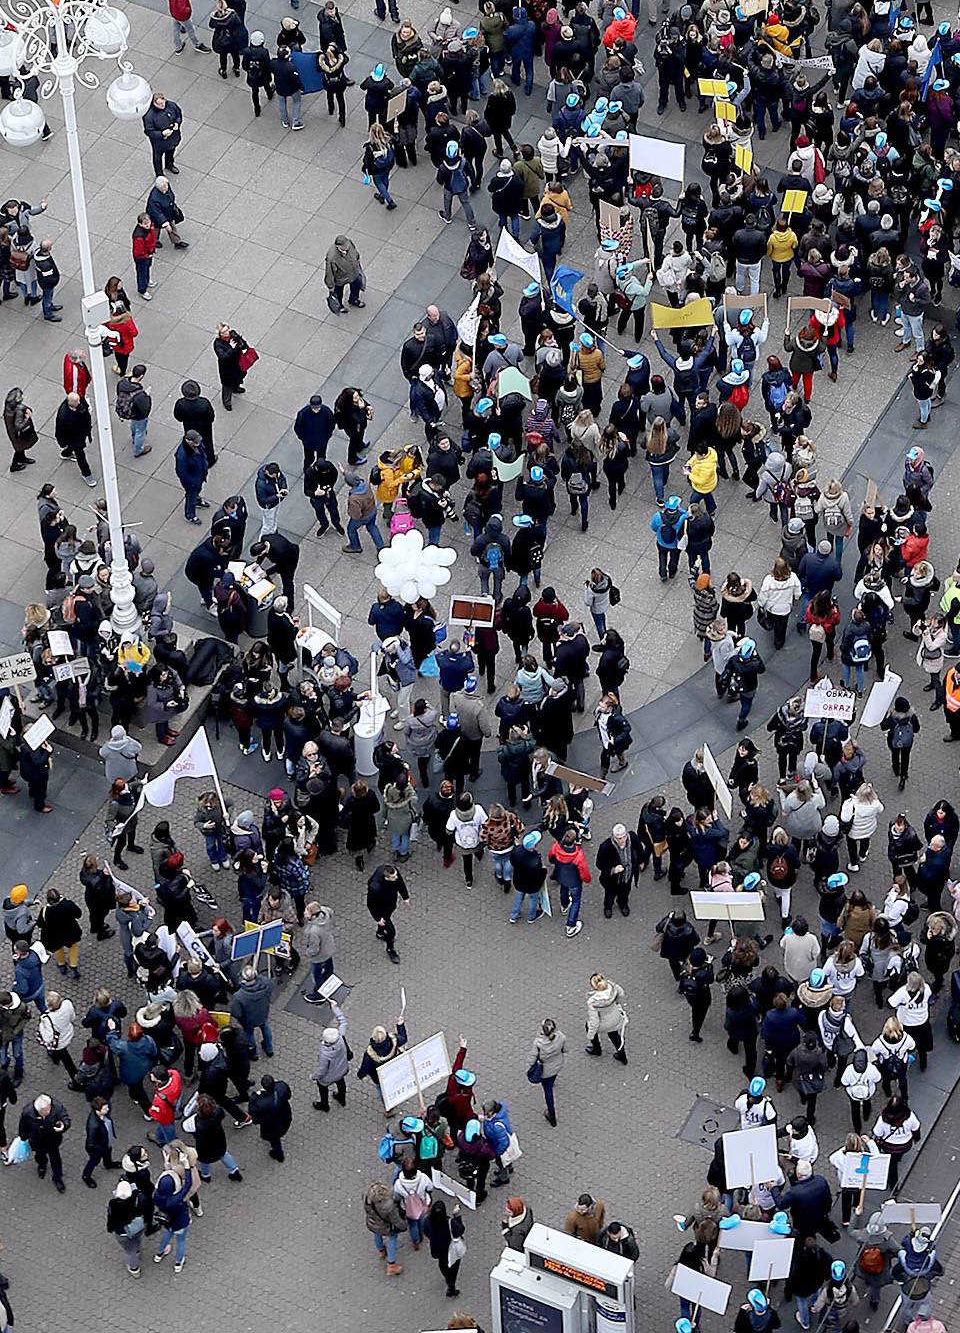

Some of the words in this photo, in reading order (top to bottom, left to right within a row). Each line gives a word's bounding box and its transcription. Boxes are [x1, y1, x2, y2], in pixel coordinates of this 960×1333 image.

[16, 657, 31, 666] SMO
[826, 689, 854, 699] OBRAZ
[822, 703, 850, 712] OBRAZ
